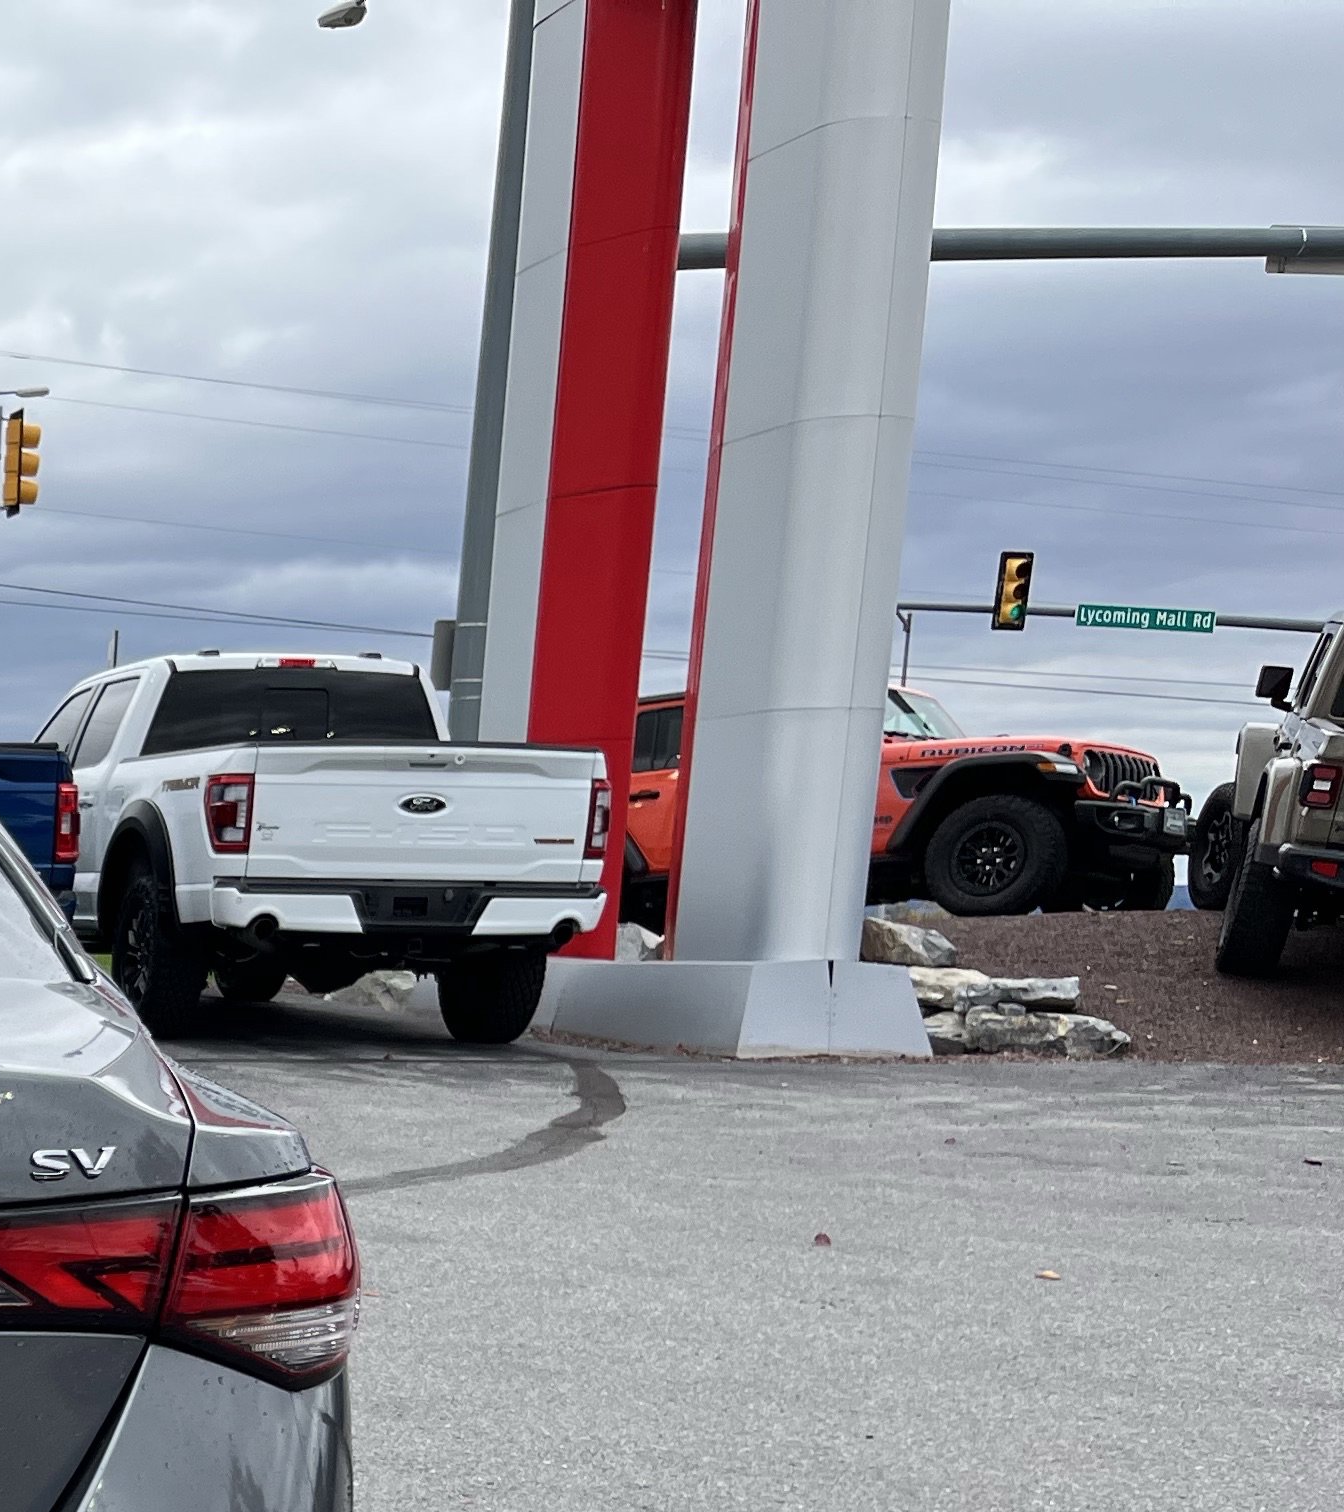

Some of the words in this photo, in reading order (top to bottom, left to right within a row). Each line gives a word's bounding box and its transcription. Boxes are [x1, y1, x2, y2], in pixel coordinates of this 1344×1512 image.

[1080, 606, 1150, 629] Lycoming
[1156, 611, 1187, 627] Mall
[1193, 613, 1212, 629] Rd
[920, 744, 1026, 758] RUBICON
[30, 1146, 117, 1181] SV
